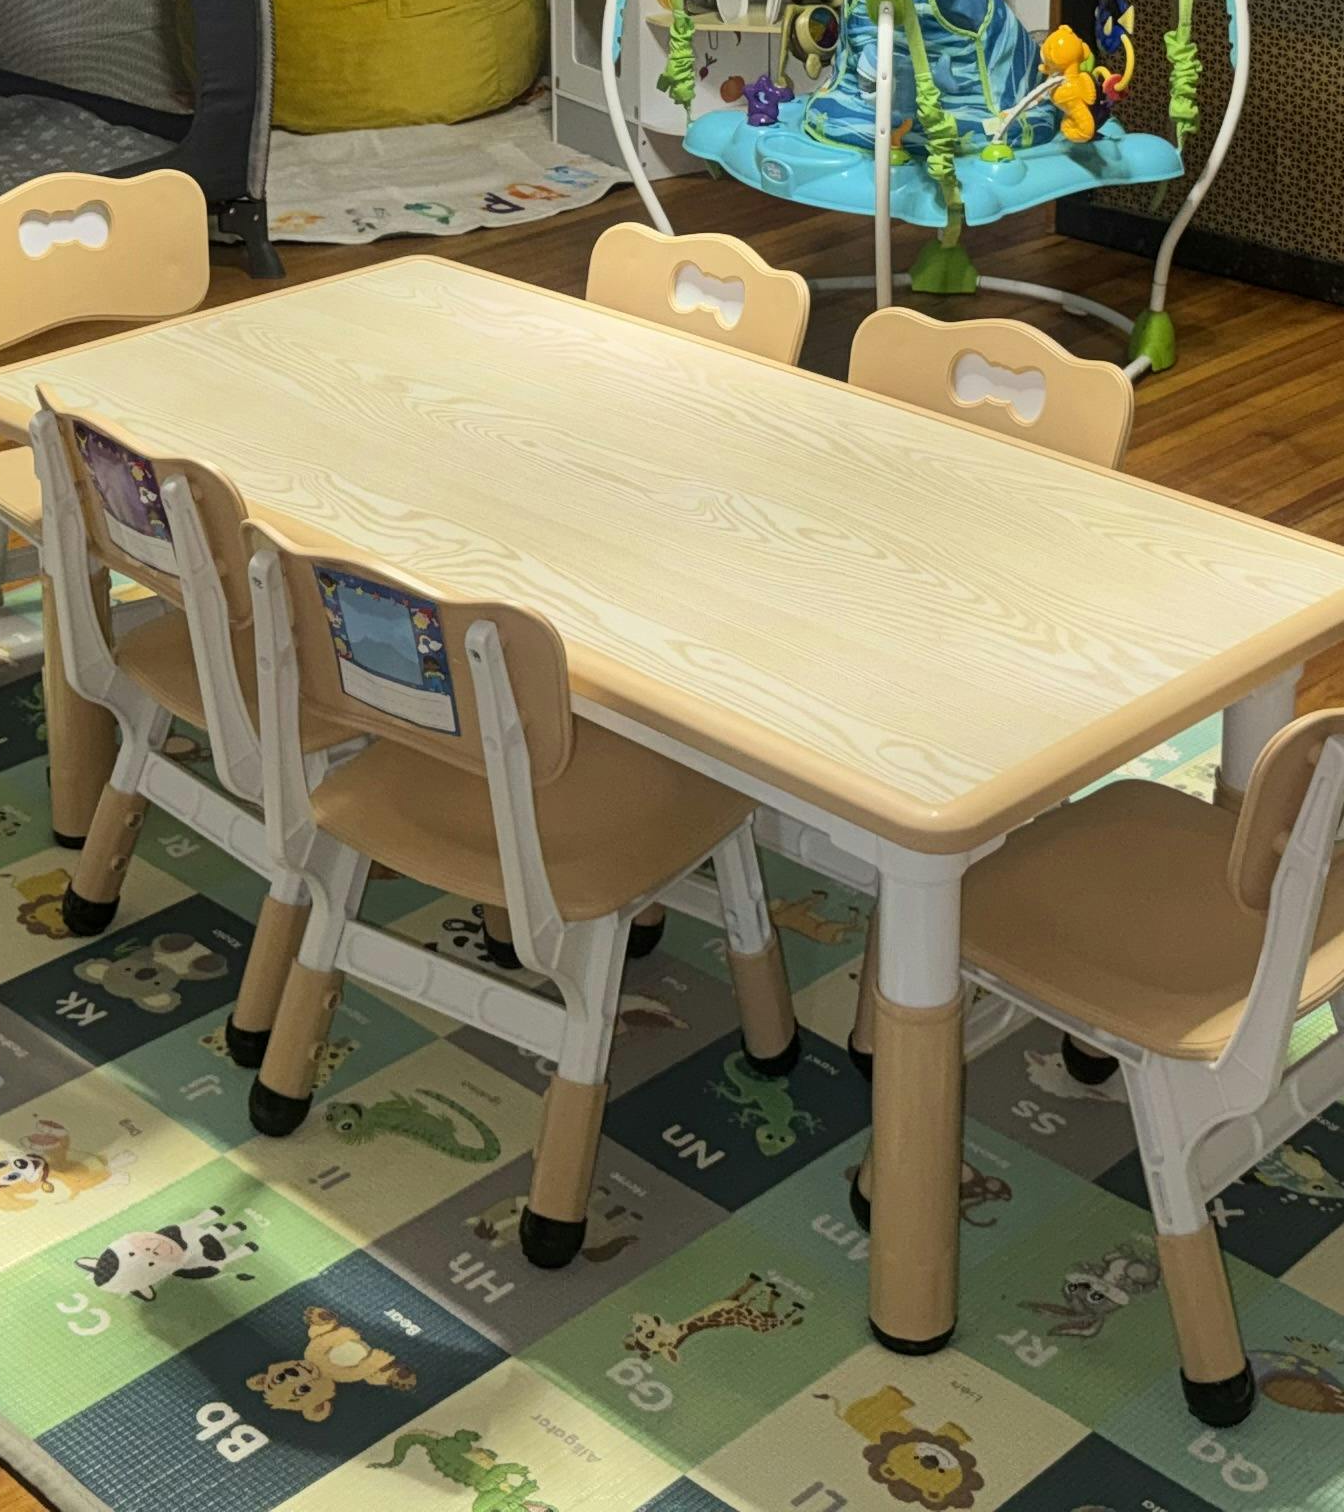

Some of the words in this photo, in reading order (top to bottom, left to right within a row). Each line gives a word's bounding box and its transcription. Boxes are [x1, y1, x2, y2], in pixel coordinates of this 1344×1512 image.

[56, 991, 112, 1028] Kk
[661, 1123, 726, 1170] Nn
[448, 1251, 515, 1306] Hh
[57, 1291, 112, 1338] Cc
[384, 1307, 424, 1337] Bear
[997, 1328, 1058, 1369] Rr
[606, 1356, 674, 1413] Gg
[195, 1399, 269, 1464] Bb
[1186, 1428, 1268, 1492] Qq
